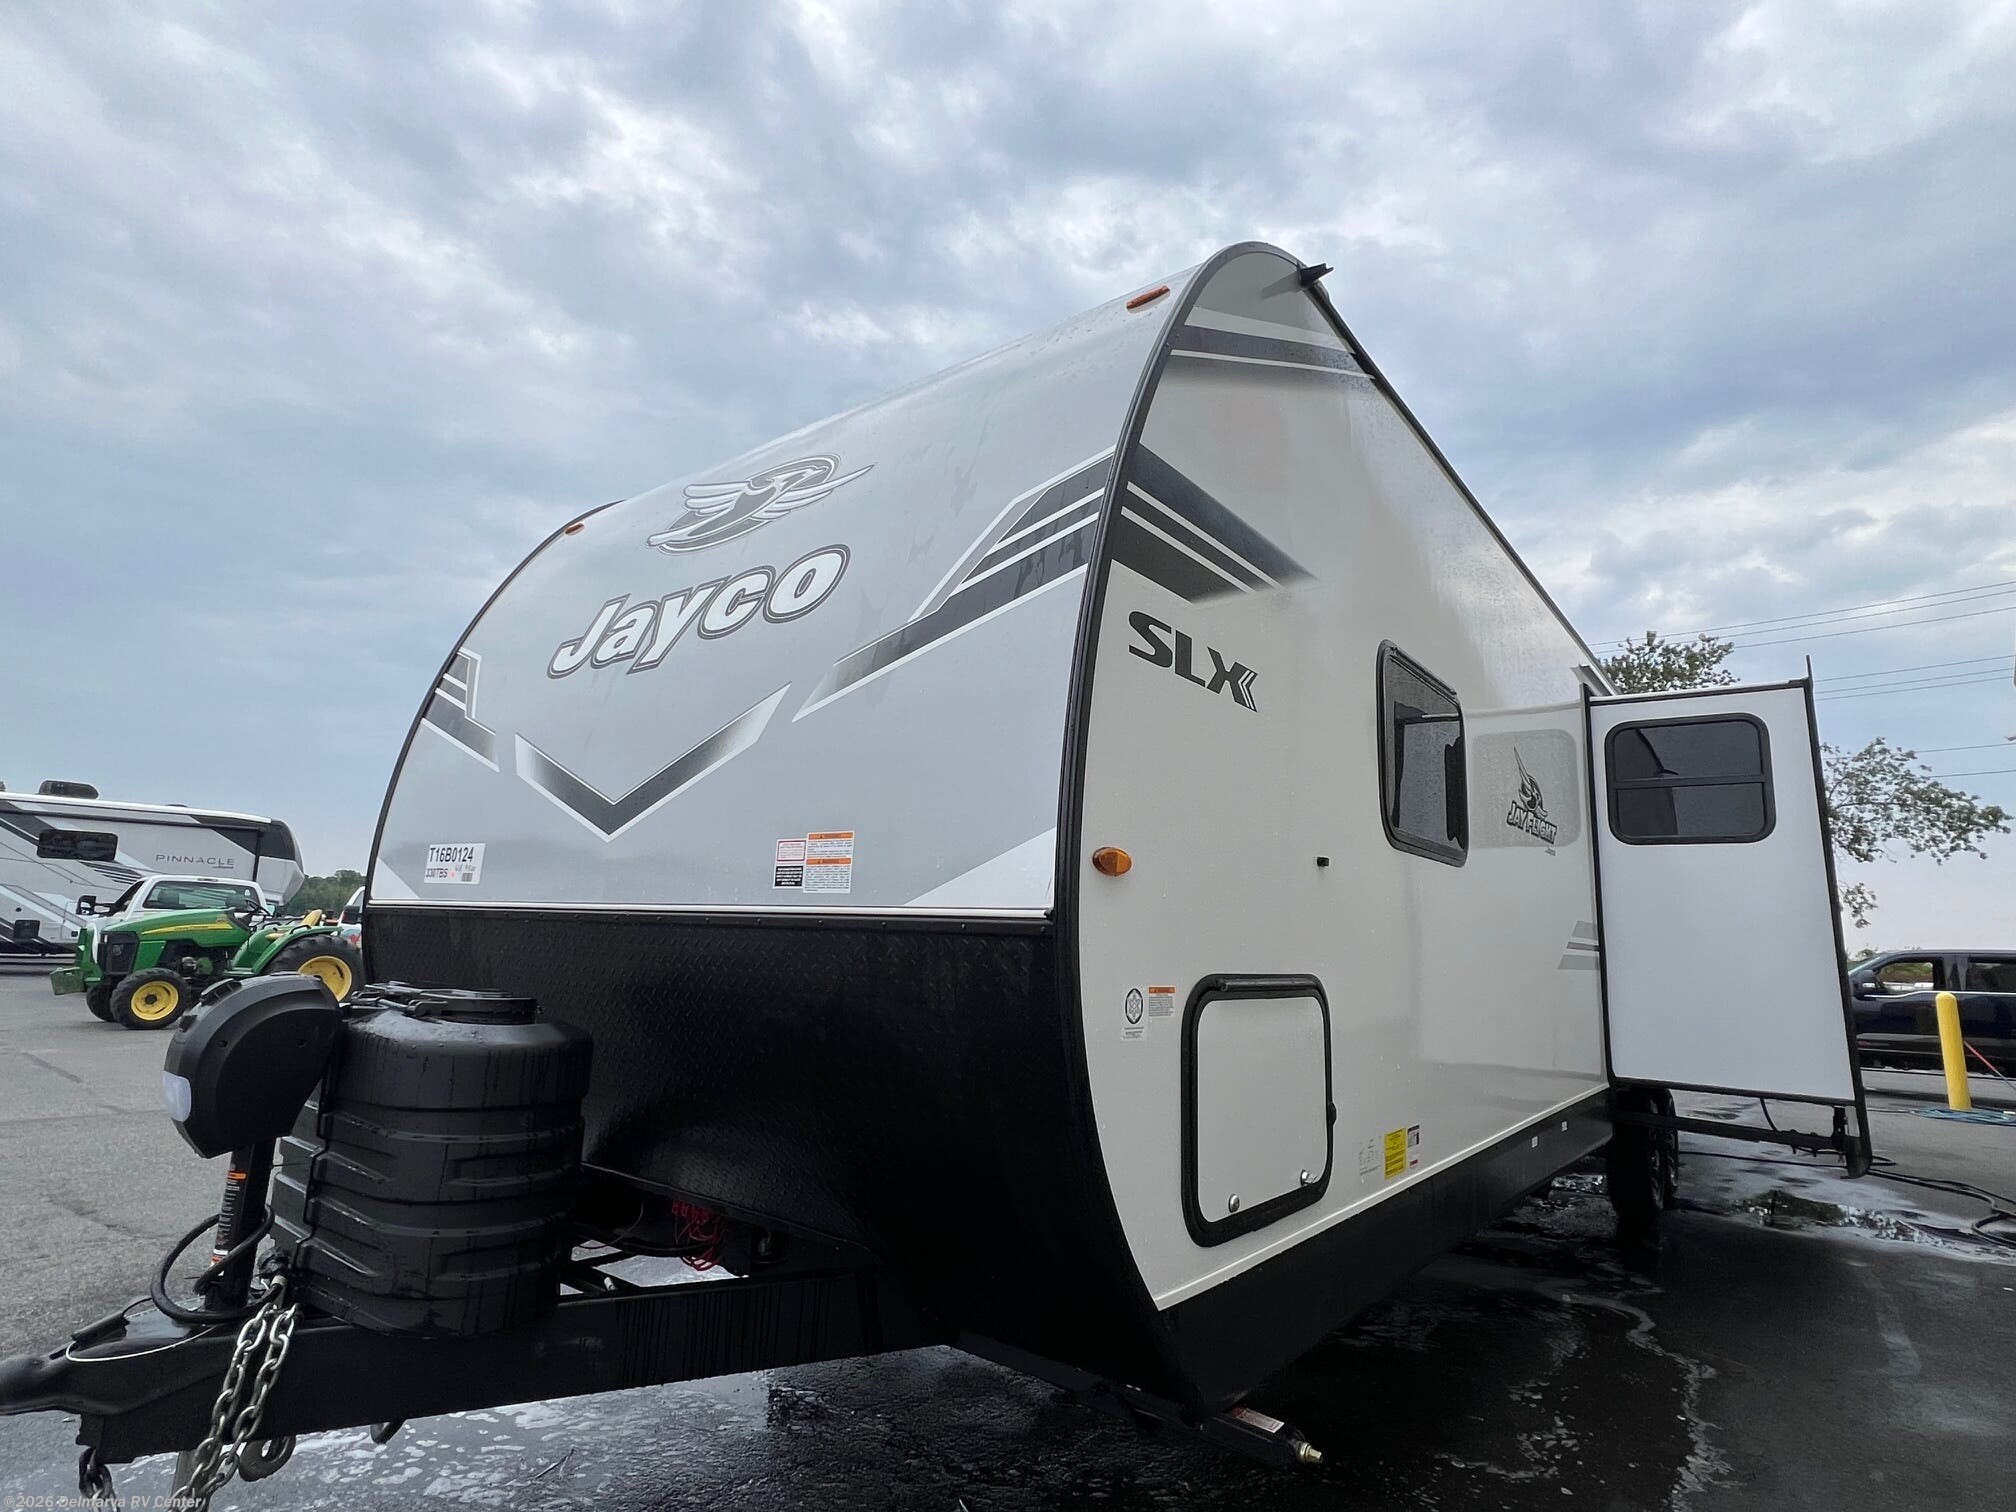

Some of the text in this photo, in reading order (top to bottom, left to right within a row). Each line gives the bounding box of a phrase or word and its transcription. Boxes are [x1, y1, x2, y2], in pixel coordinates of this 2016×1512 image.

[547, 543, 851, 679] Jayco
[1129, 611, 1258, 712] SLX
[1507, 801, 1558, 844] JAY FLIGHT
[155, 854, 235, 866] PINNACLE
[429, 847, 474, 862] T16B0124
